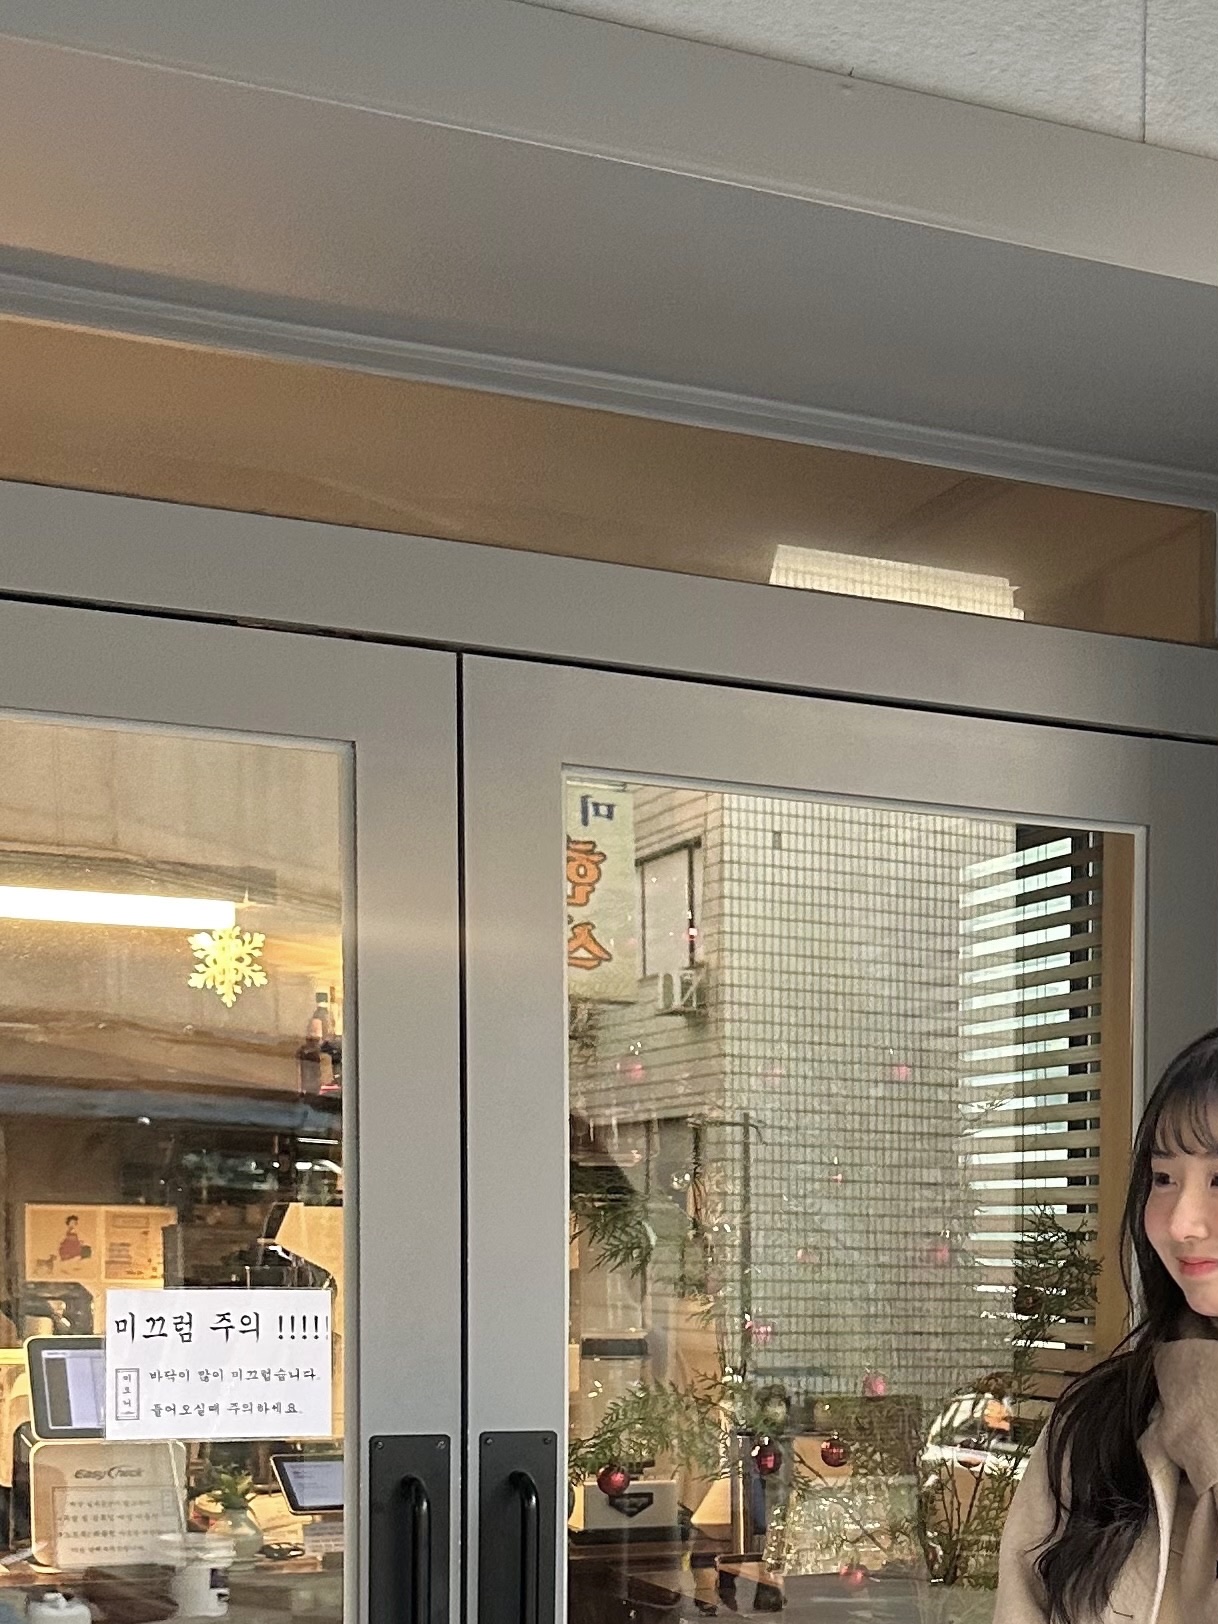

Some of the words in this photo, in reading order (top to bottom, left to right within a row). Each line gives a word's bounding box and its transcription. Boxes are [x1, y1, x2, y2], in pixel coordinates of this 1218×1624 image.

[115, 1312, 192, 1343] 미끄럼
[210, 1312, 259, 1343] 주의
[149, 1368, 190, 1382] 바닥이
[198, 1368, 223, 1382] 많이
